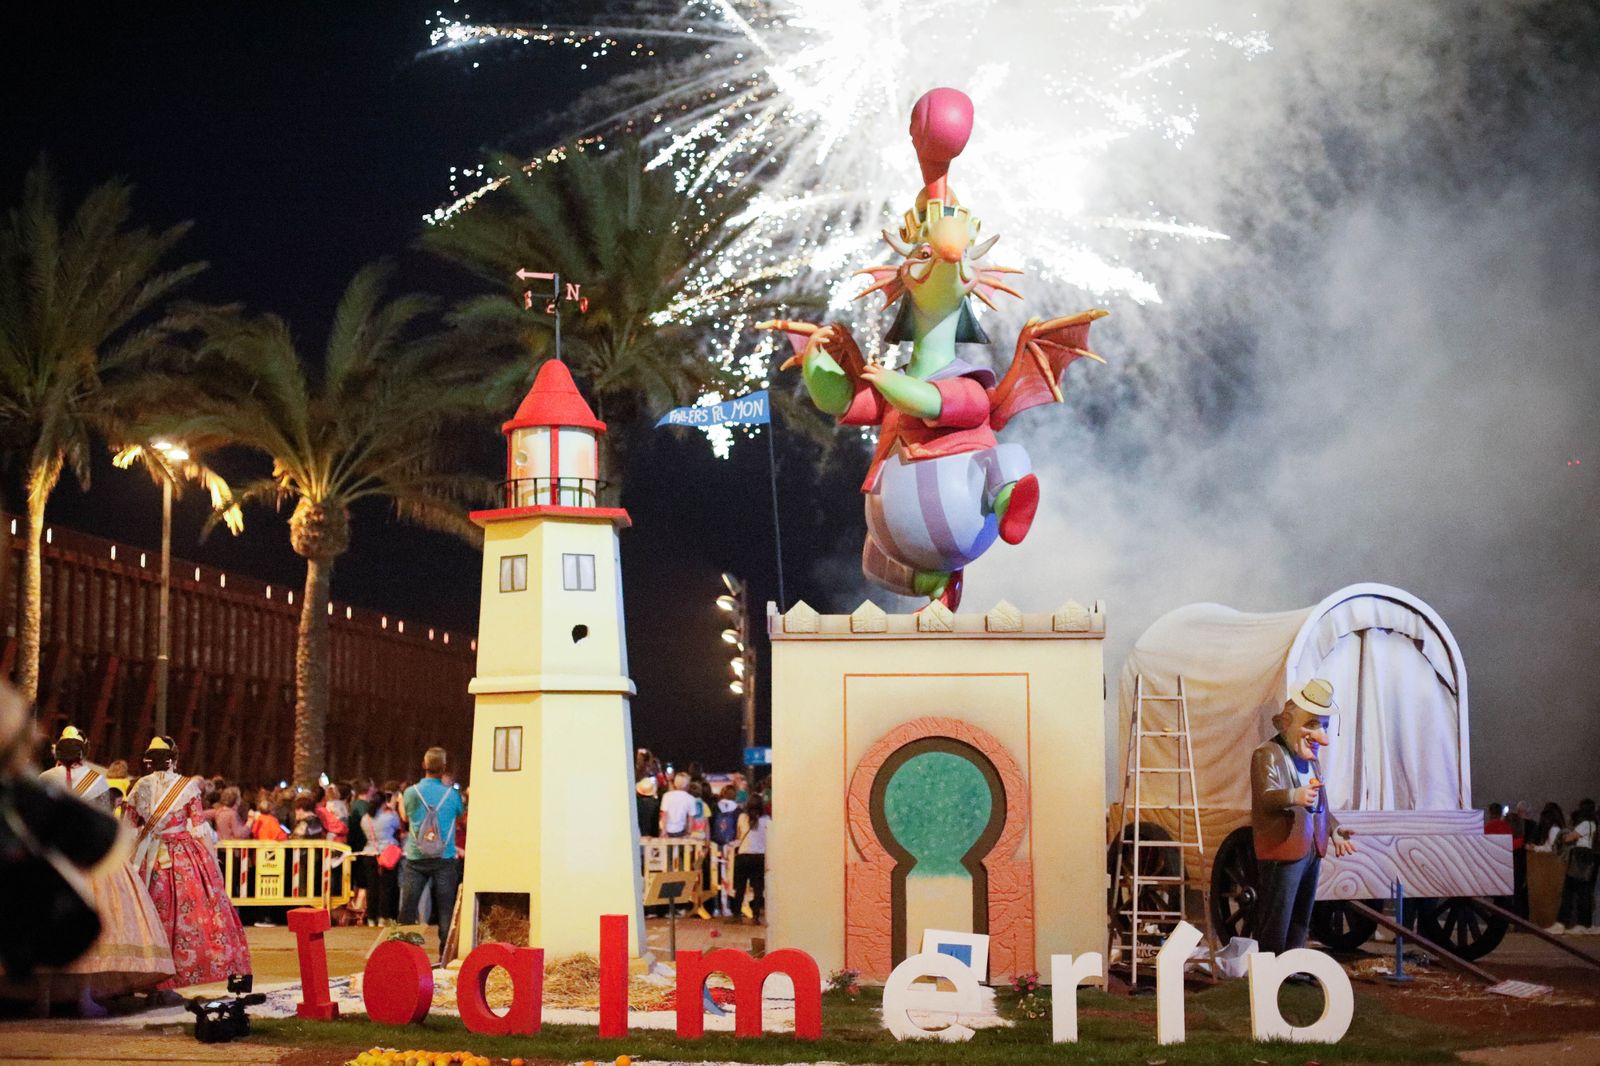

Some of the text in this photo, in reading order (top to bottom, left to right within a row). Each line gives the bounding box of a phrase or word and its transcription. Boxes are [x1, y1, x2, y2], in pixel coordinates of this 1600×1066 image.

[565, 283, 581, 301] N
[669, 409, 709, 424] FALLERS
[731, 398, 764, 420] MON
